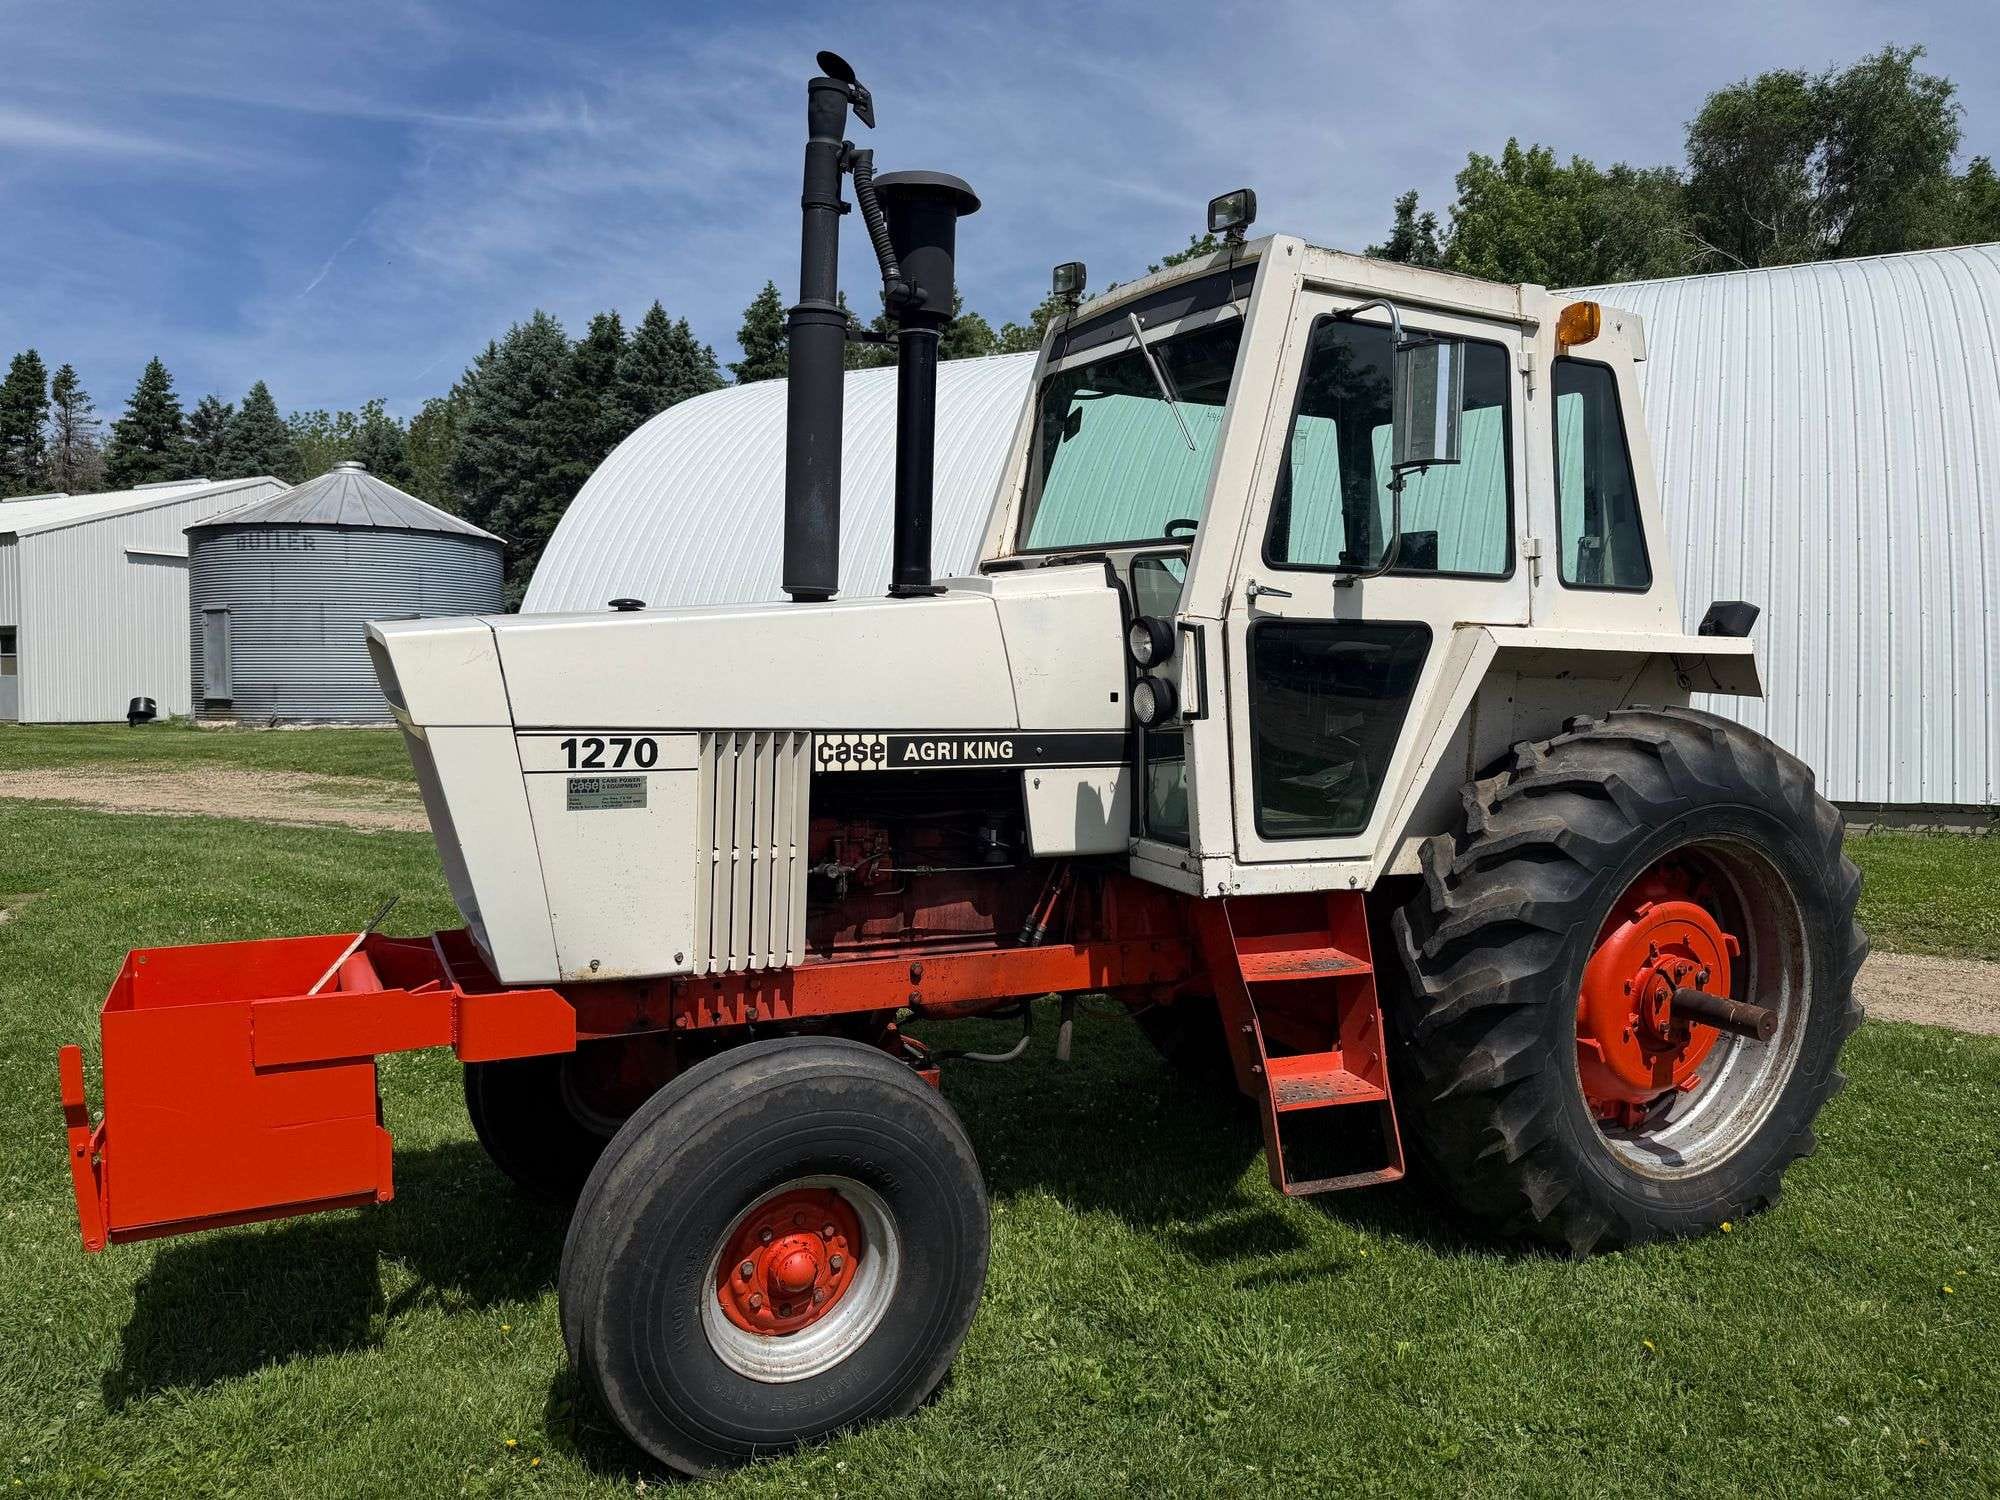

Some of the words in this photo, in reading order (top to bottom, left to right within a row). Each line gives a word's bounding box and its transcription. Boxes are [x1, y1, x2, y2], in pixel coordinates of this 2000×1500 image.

[236, 531, 315, 551] BUTLER
[560, 737, 659, 769] 1270
[816, 738, 886, 768] case
[902, 741, 958, 761] AGRI
[963, 740, 1014, 760] KING
